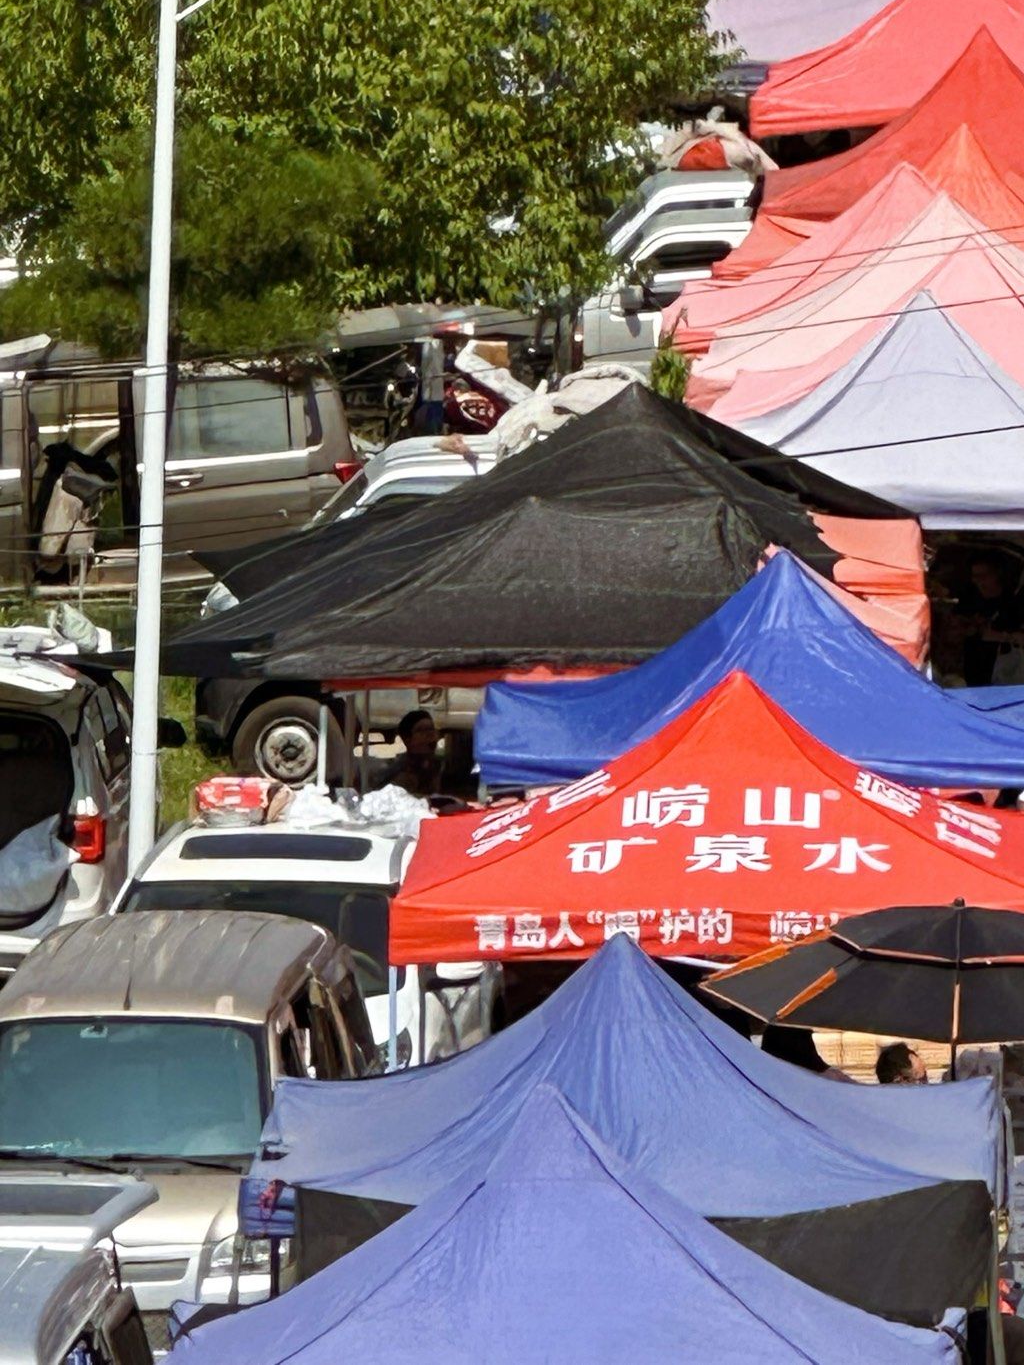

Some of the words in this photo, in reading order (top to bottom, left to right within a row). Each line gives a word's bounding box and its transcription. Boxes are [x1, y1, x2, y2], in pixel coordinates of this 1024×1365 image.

[621, 784, 821, 829] 崂山
[566, 833, 892, 875] 矿泉水
